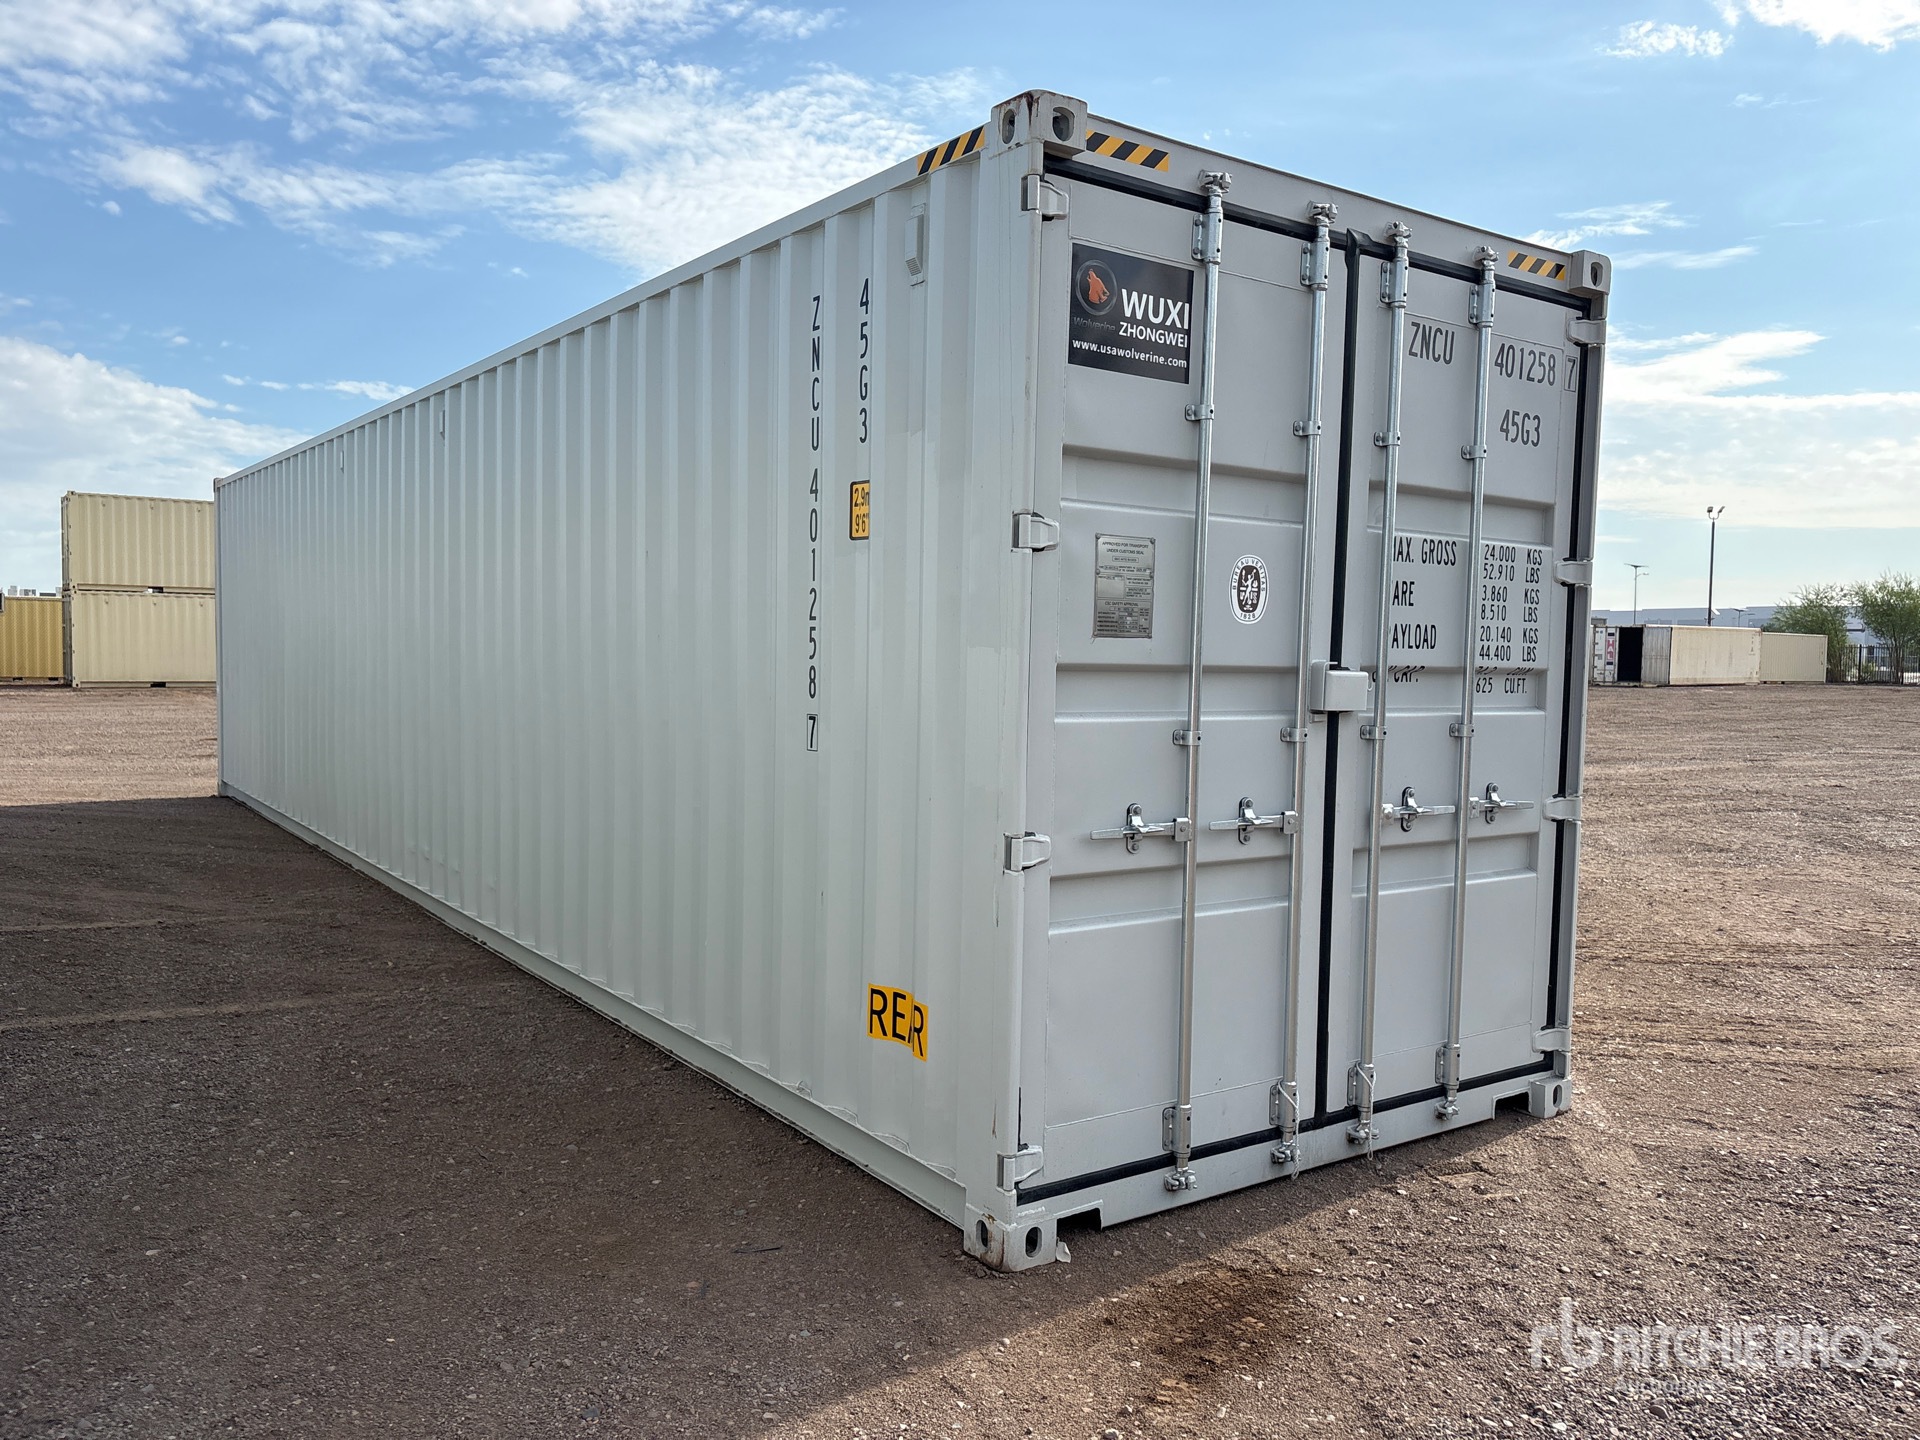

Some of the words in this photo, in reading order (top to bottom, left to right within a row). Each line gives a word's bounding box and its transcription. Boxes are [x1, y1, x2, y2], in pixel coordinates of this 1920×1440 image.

[1073, 315, 1116, 332] Wolverine
[1121, 288, 1190, 330] WUXI
[1118, 321, 1188, 348] ZHONGWEI
[859, 277, 870, 444] 45G3
[1072, 339, 1187, 368] www.usawolverine.com
[1408, 321, 1455, 365] ZNCU
[1494, 342, 1556, 386] 401258
[1566, 357, 1577, 391] 7
[811, 295, 821, 451] ZNCU
[1499, 409, 1541, 447] 45G3
[1393, 536, 1415, 563] AX.
[1421, 538, 1457, 566] GROSS
[1526, 548, 1543, 566] KGS
[808, 467, 819, 699] 401258
[1232, 558, 1250, 590] BUREAU
[1251, 559, 1266, 592] VERITAS
[1525, 567, 1540, 584] LBS
[1392, 581, 1415, 607] ARE
[1524, 588, 1540, 605] KGS
[1240, 612, 1256, 620] 1828
[1523, 607, 1538, 623] LBS
[1391, 624, 1437, 650] AYLOAD
[1522, 628, 1539, 644] KGS
[1522, 646, 1537, 662] LBS
